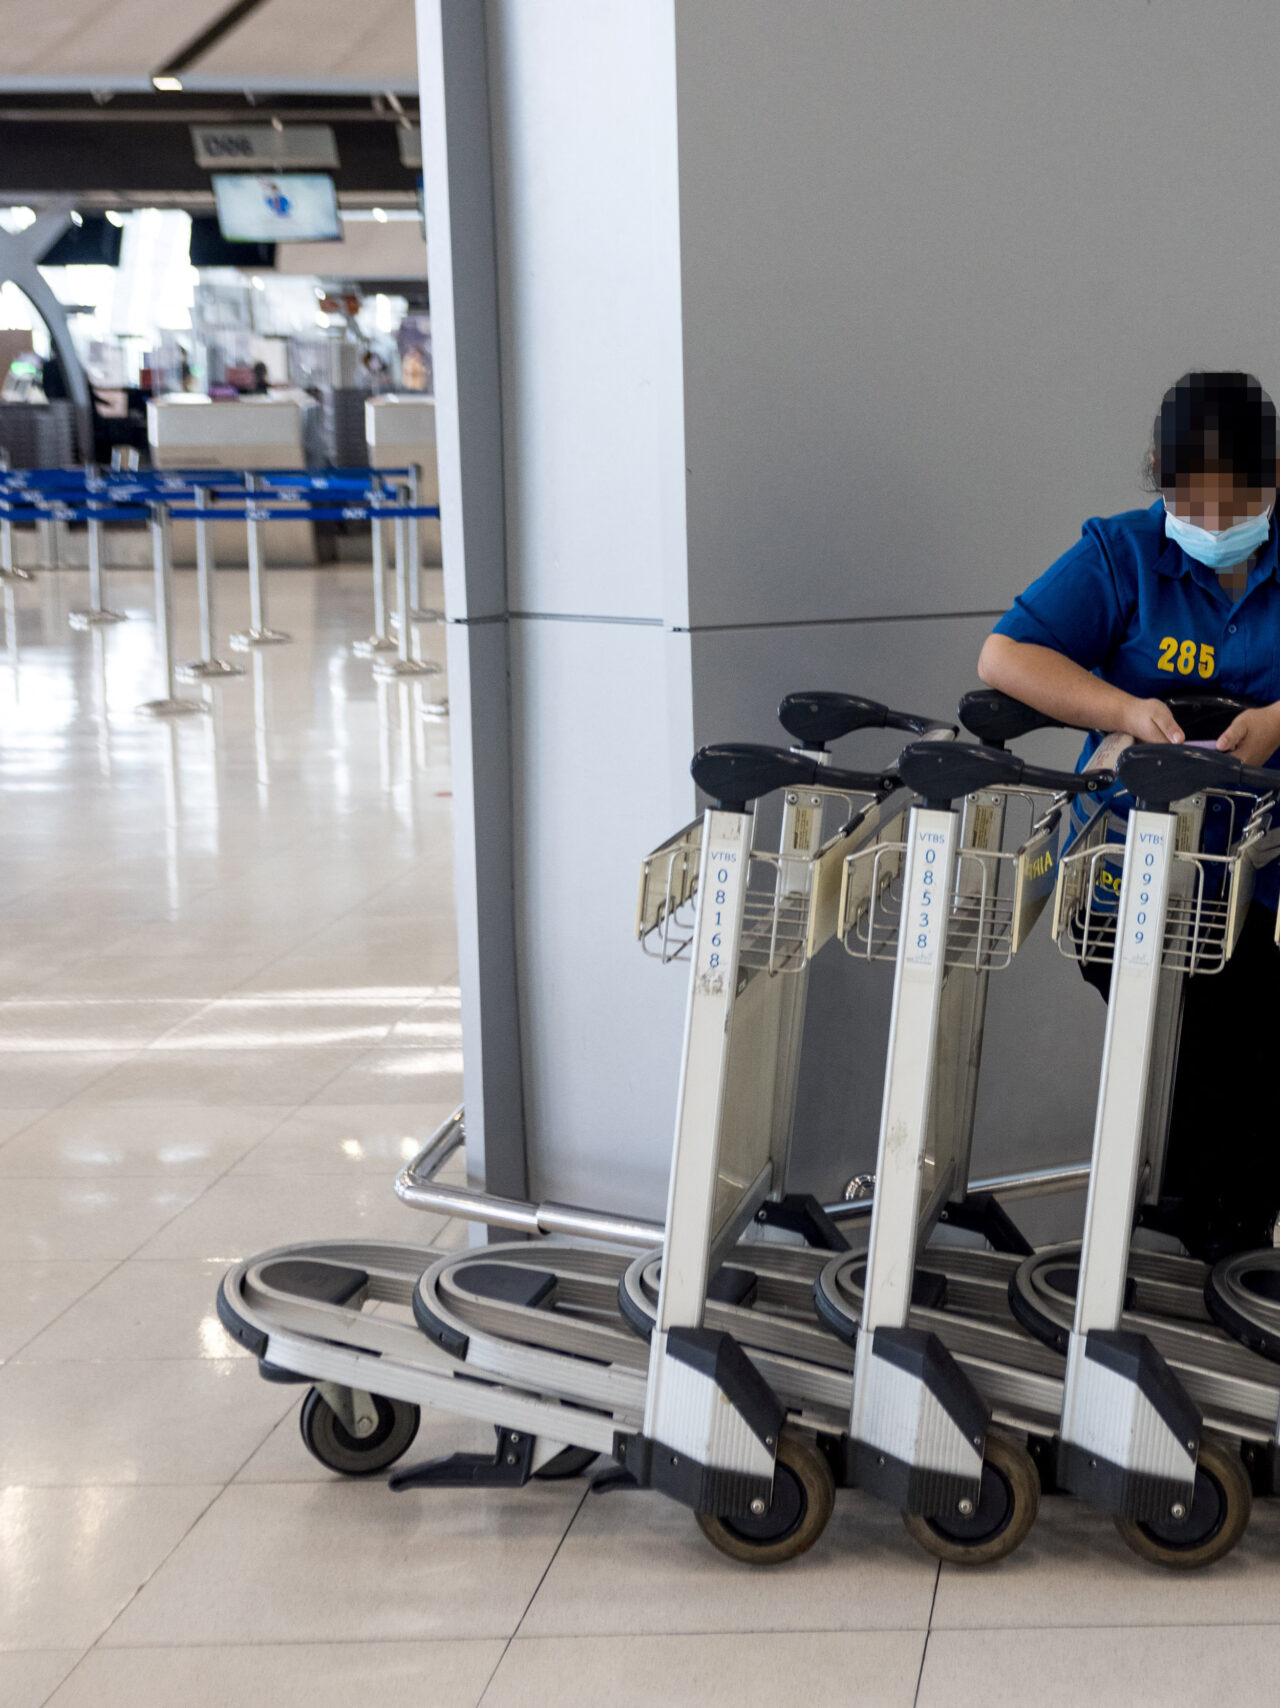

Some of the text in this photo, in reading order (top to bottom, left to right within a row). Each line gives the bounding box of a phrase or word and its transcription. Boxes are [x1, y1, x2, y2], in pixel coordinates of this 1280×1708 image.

[1157, 636, 1215, 679] 285
[918, 832, 945, 844] VTBS
[709, 868, 728, 968] 08168
[917, 848, 936, 949] 08538
[1135, 853, 1155, 944] 09909
